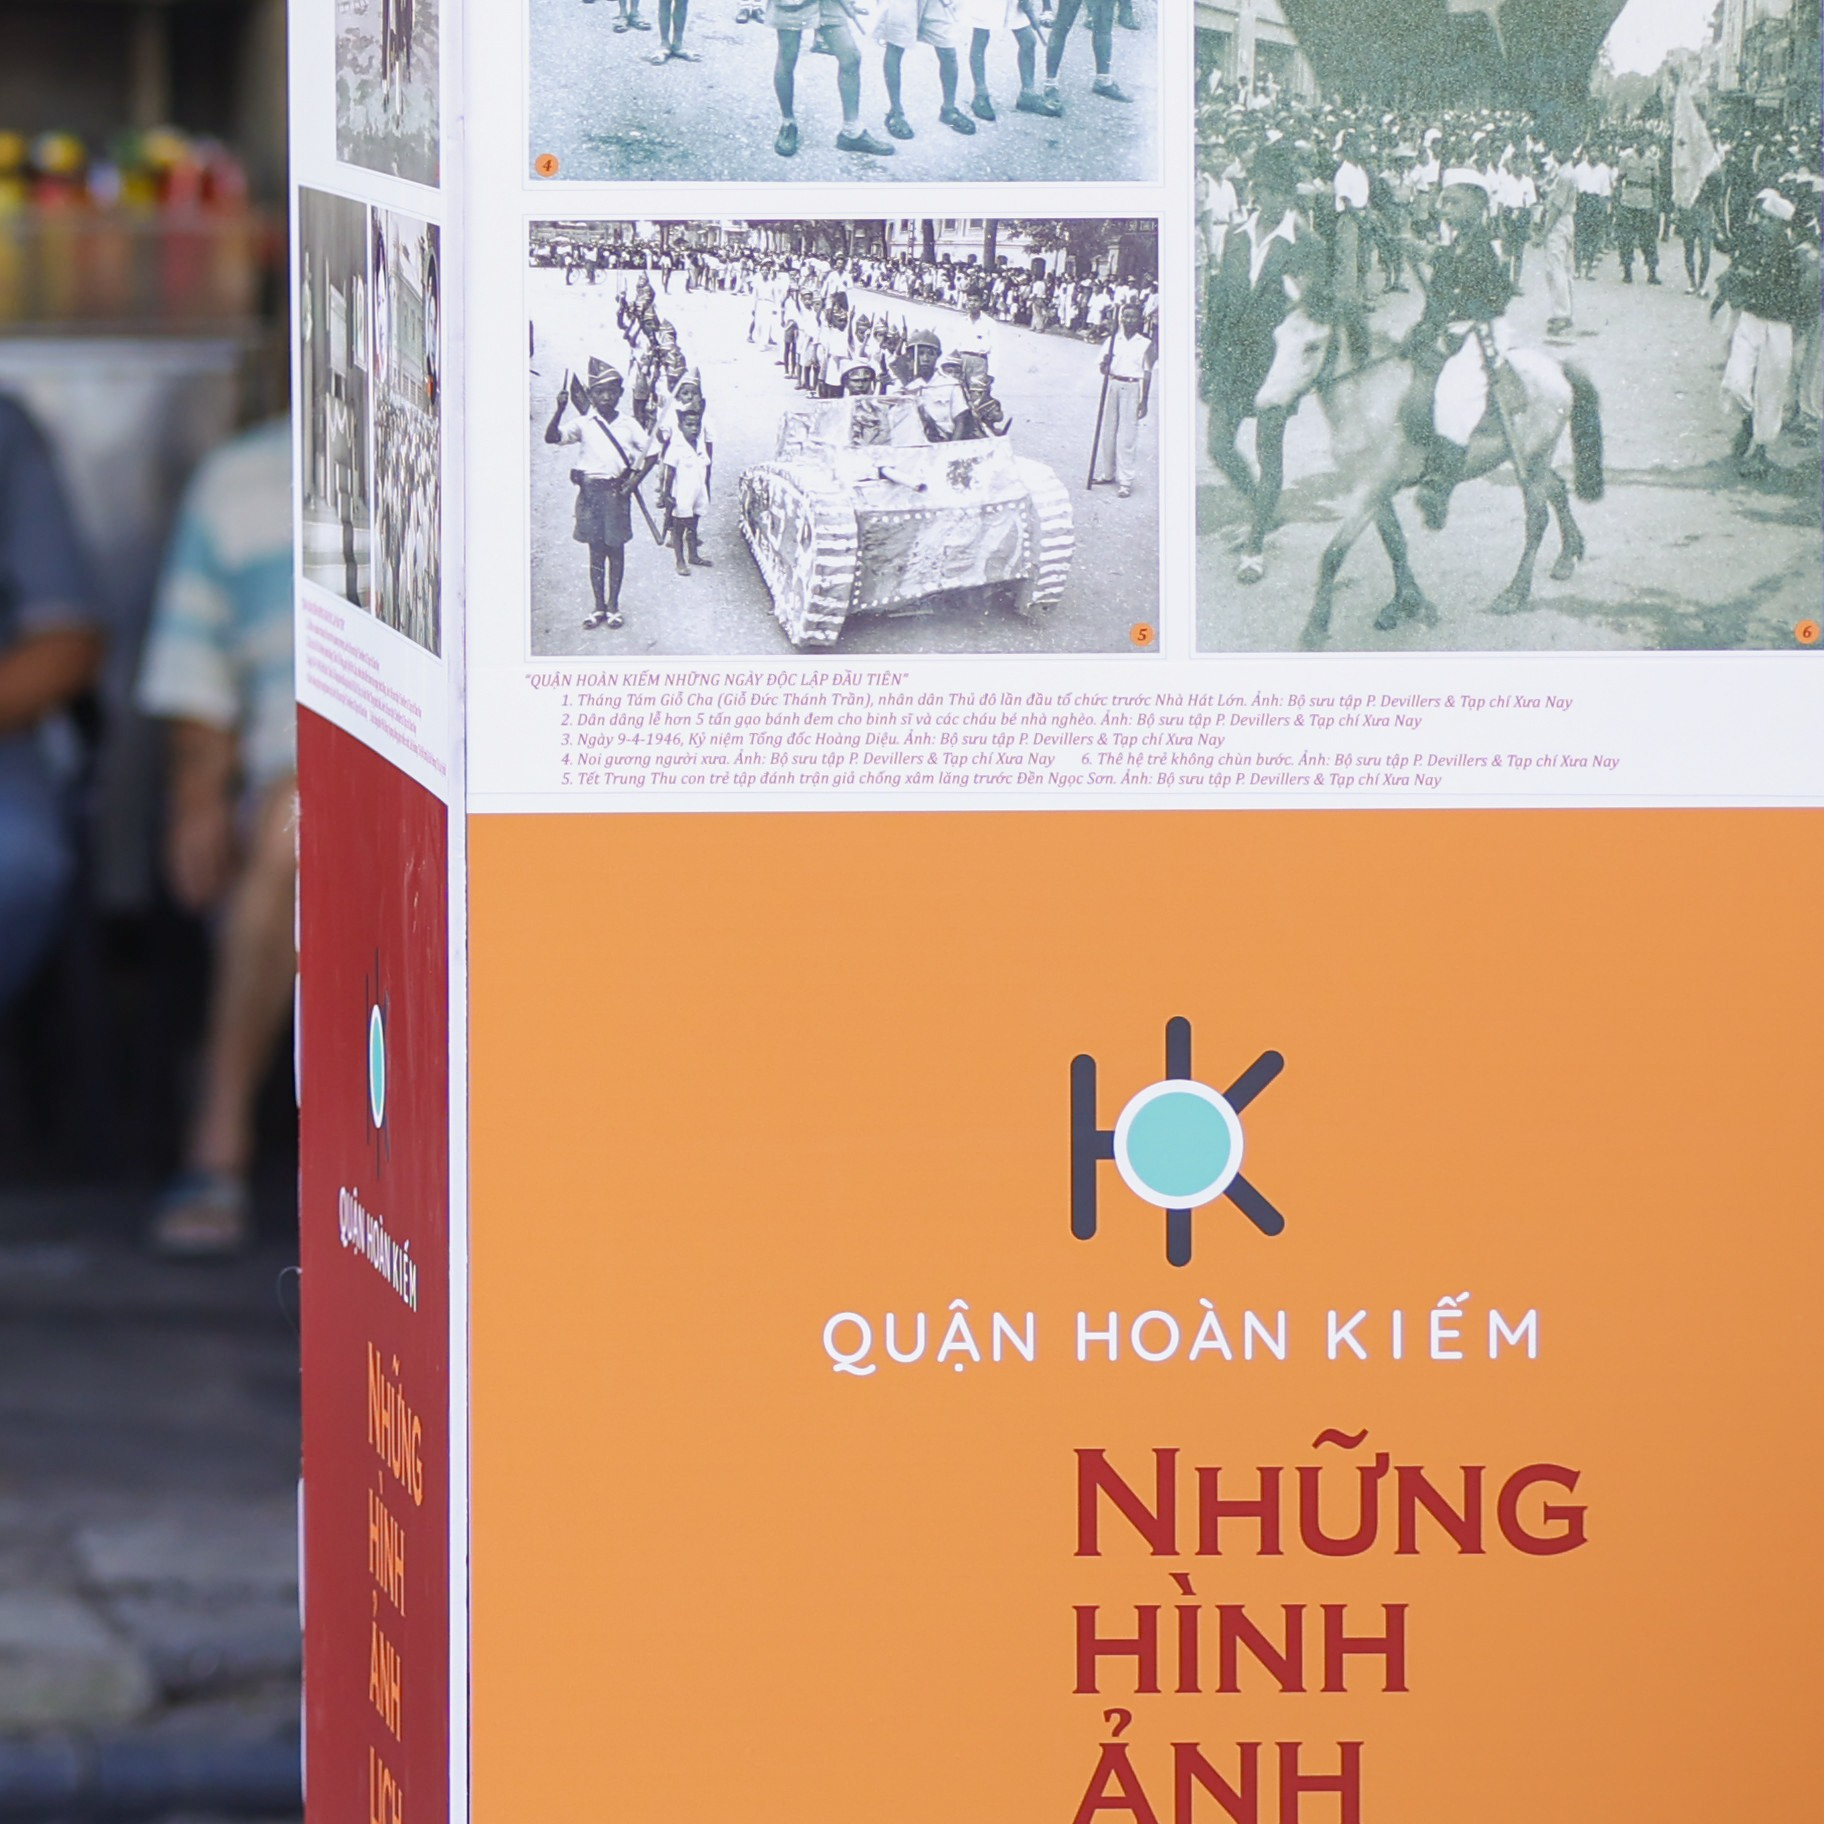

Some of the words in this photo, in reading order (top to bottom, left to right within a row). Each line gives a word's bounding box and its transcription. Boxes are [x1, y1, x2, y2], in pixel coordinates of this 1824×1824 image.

[823, 1299, 1035, 1376] QUẬN
[1077, 1298, 1286, 1362] HOÀN
[1328, 1292, 1538, 1360] KIẾM
[367, 1341, 423, 1508] NHỮNG
[368, 1470, 406, 1617] HÌNH
[1074, 1429, 1587, 1556] NHỮNG
[369, 1601, 401, 1743] ẢNH
[1073, 1573, 1408, 1693] HÌNH
[1073, 1708, 1363, 1824] ẢNH
